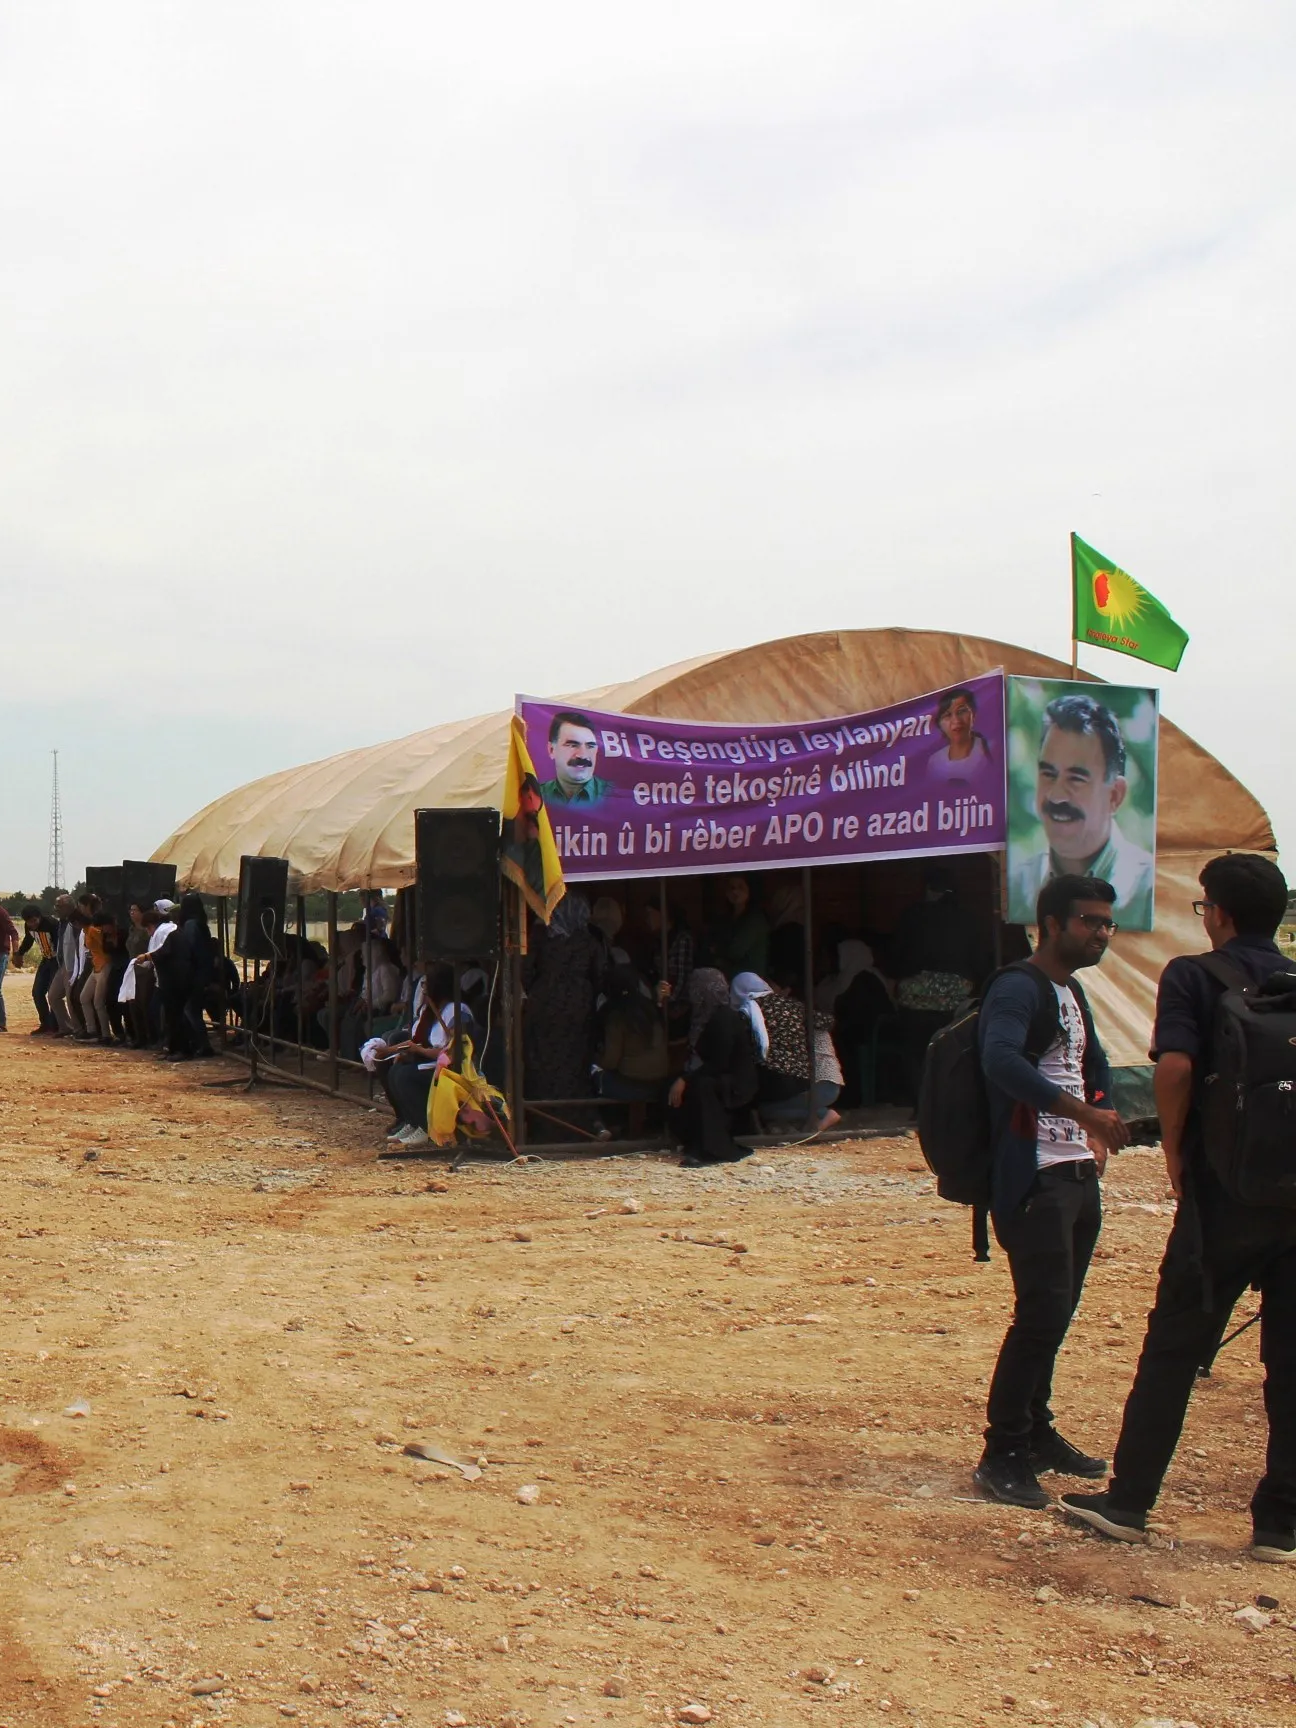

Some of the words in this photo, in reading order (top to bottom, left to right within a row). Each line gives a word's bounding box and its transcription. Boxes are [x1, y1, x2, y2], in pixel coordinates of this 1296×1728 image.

[1120, 636, 1139, 650] Star
[600, 730, 632, 759] Bi
[637, 733, 798, 766] Peşengtiya
[799, 713, 933, 755] leylanyan
[634, 771, 696, 806] emê
[705, 764, 821, 808] tekoşînê
[830, 755, 906, 793] bilind
[555, 825, 607, 857] ikin
[617, 821, 635, 855] û
[645, 822, 671, 854] bi
[680, 818, 756, 851] rêber
[762, 811, 824, 846] APO
[832, 816, 859, 840] re
[867, 802, 929, 837] azad
[937, 795, 993, 837] bijîn
